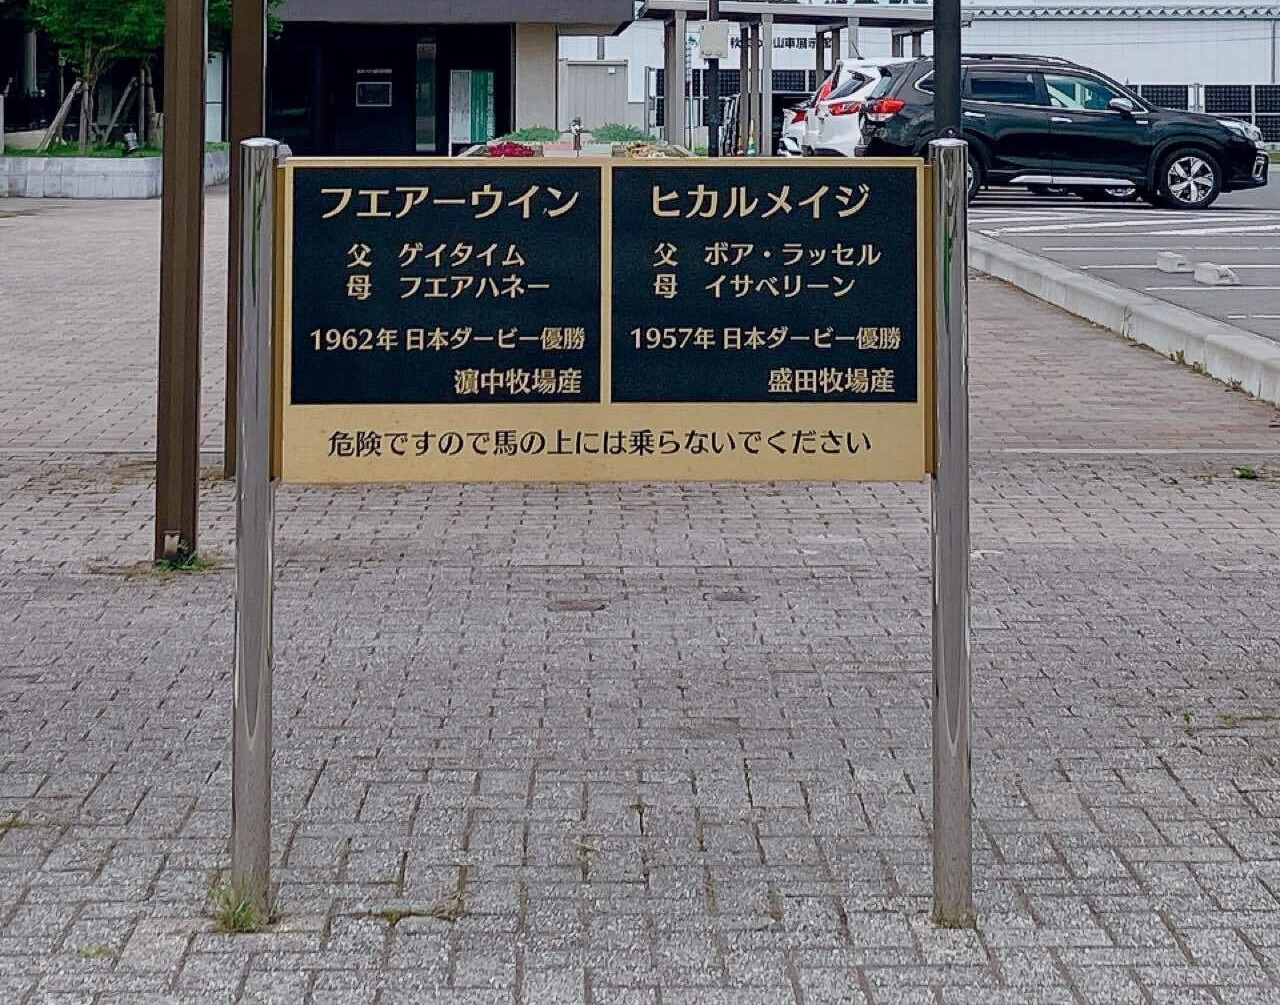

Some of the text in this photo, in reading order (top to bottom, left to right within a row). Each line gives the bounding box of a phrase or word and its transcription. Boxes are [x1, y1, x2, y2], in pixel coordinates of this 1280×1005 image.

[320, 184, 579, 219] フエアーウイン
[652, 183, 870, 219] ヒカルメイジ
[346, 242, 526, 268] 父 ゲイタイム
[653, 241, 881, 267] 父 ボア・ラッセル
[346, 273, 550, 301] 母 フエアハネー
[653, 273, 856, 299] 母 イサベリーン
[310, 326, 586, 352] 1962年 日本ダービー優勝
[630, 325, 901, 351] 1957年 日本ダービー優勝
[768, 367, 895, 394] 盛田牧場産
[328, 428, 872, 458] 危険ですので馬の上には乗らないでください
